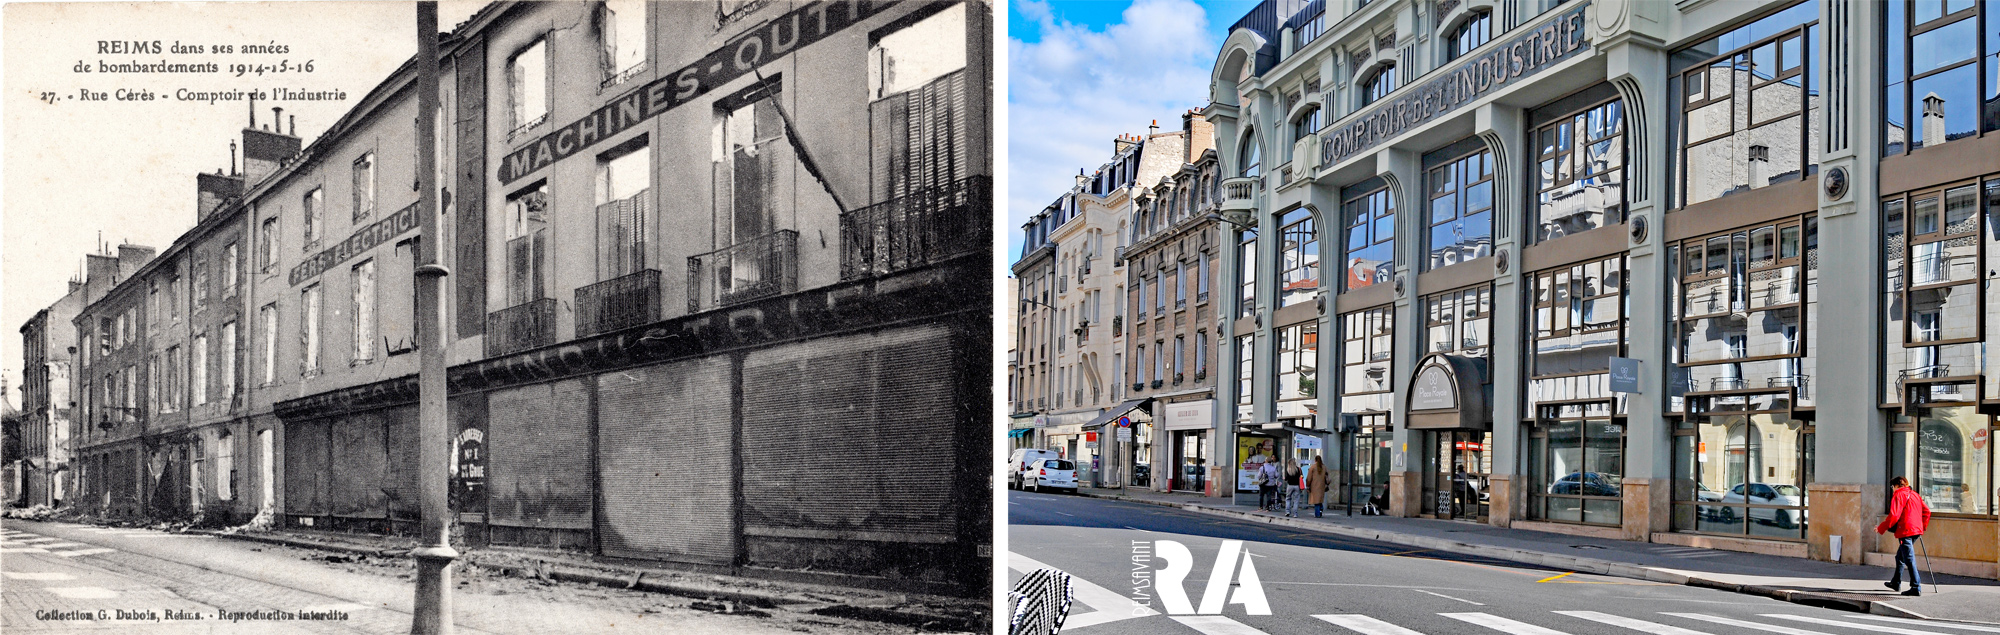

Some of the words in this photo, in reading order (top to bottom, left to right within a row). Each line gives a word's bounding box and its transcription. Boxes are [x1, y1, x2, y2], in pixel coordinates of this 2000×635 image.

[508, 0, 900, 180] MACHINES-OUTI
[1323, 101, 1407, 164] COMPTOIR
[1413, 97, 1432, 123] DE
[293, 254, 327, 284] FERS
